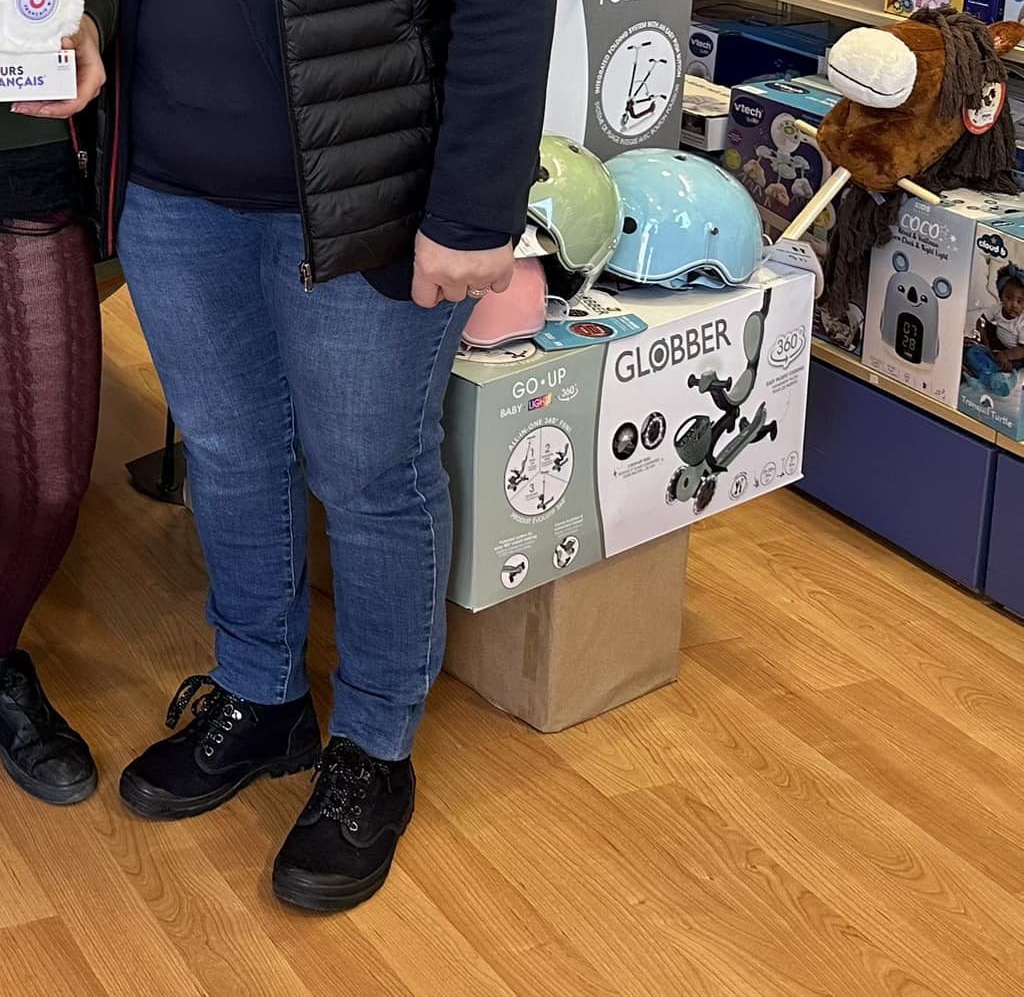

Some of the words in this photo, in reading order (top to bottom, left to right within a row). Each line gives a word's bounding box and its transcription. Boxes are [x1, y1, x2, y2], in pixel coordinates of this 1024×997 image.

[690, 38, 712, 49] vtech
[734, 102, 762, 119] vtech
[901, 213, 940, 239] COCO
[499, 403, 523, 419] BABY
[991, 410, 1013, 429] Turtle
[544, 443, 551, 453] 2
[529, 483, 535, 493] 3
